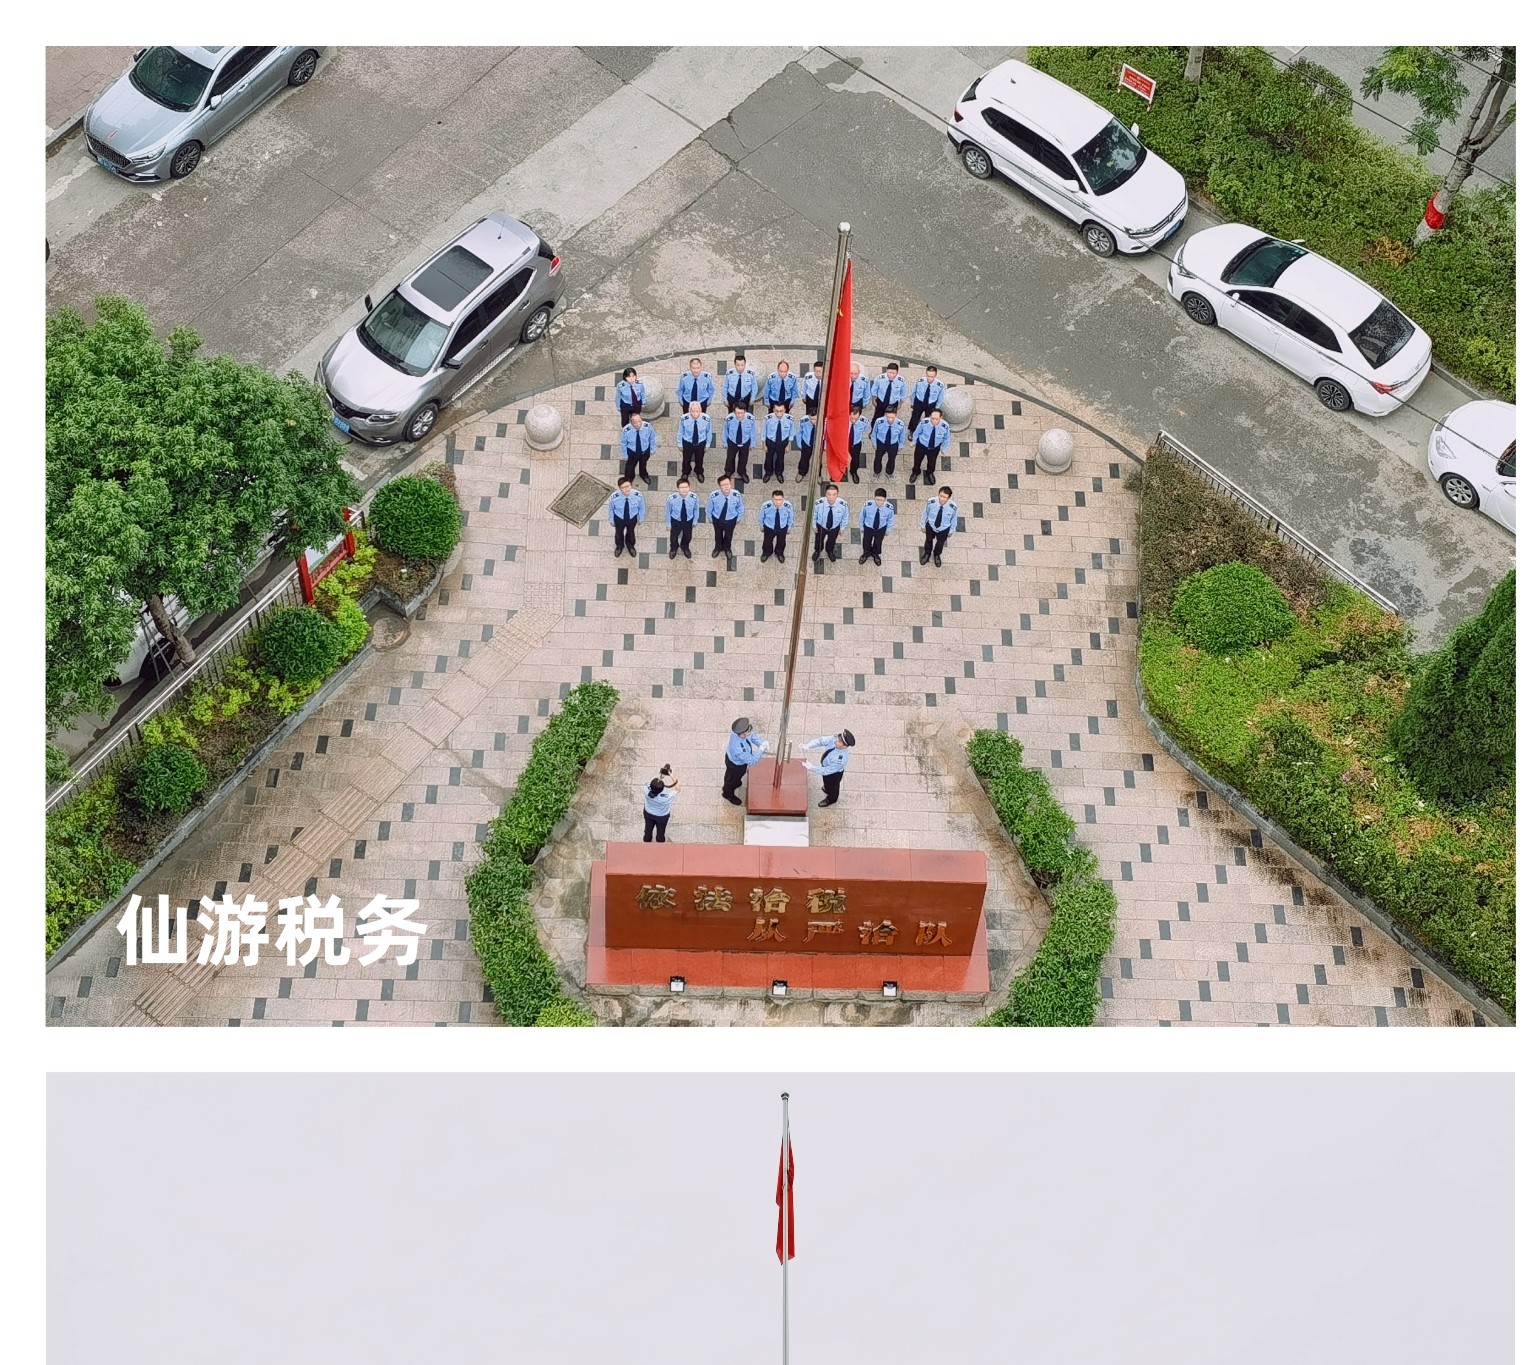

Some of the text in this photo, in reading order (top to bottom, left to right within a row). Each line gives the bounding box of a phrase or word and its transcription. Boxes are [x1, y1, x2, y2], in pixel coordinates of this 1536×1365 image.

[635, 883, 848, 915] 依法治税
[745, 917, 953, 946] 从严治队
